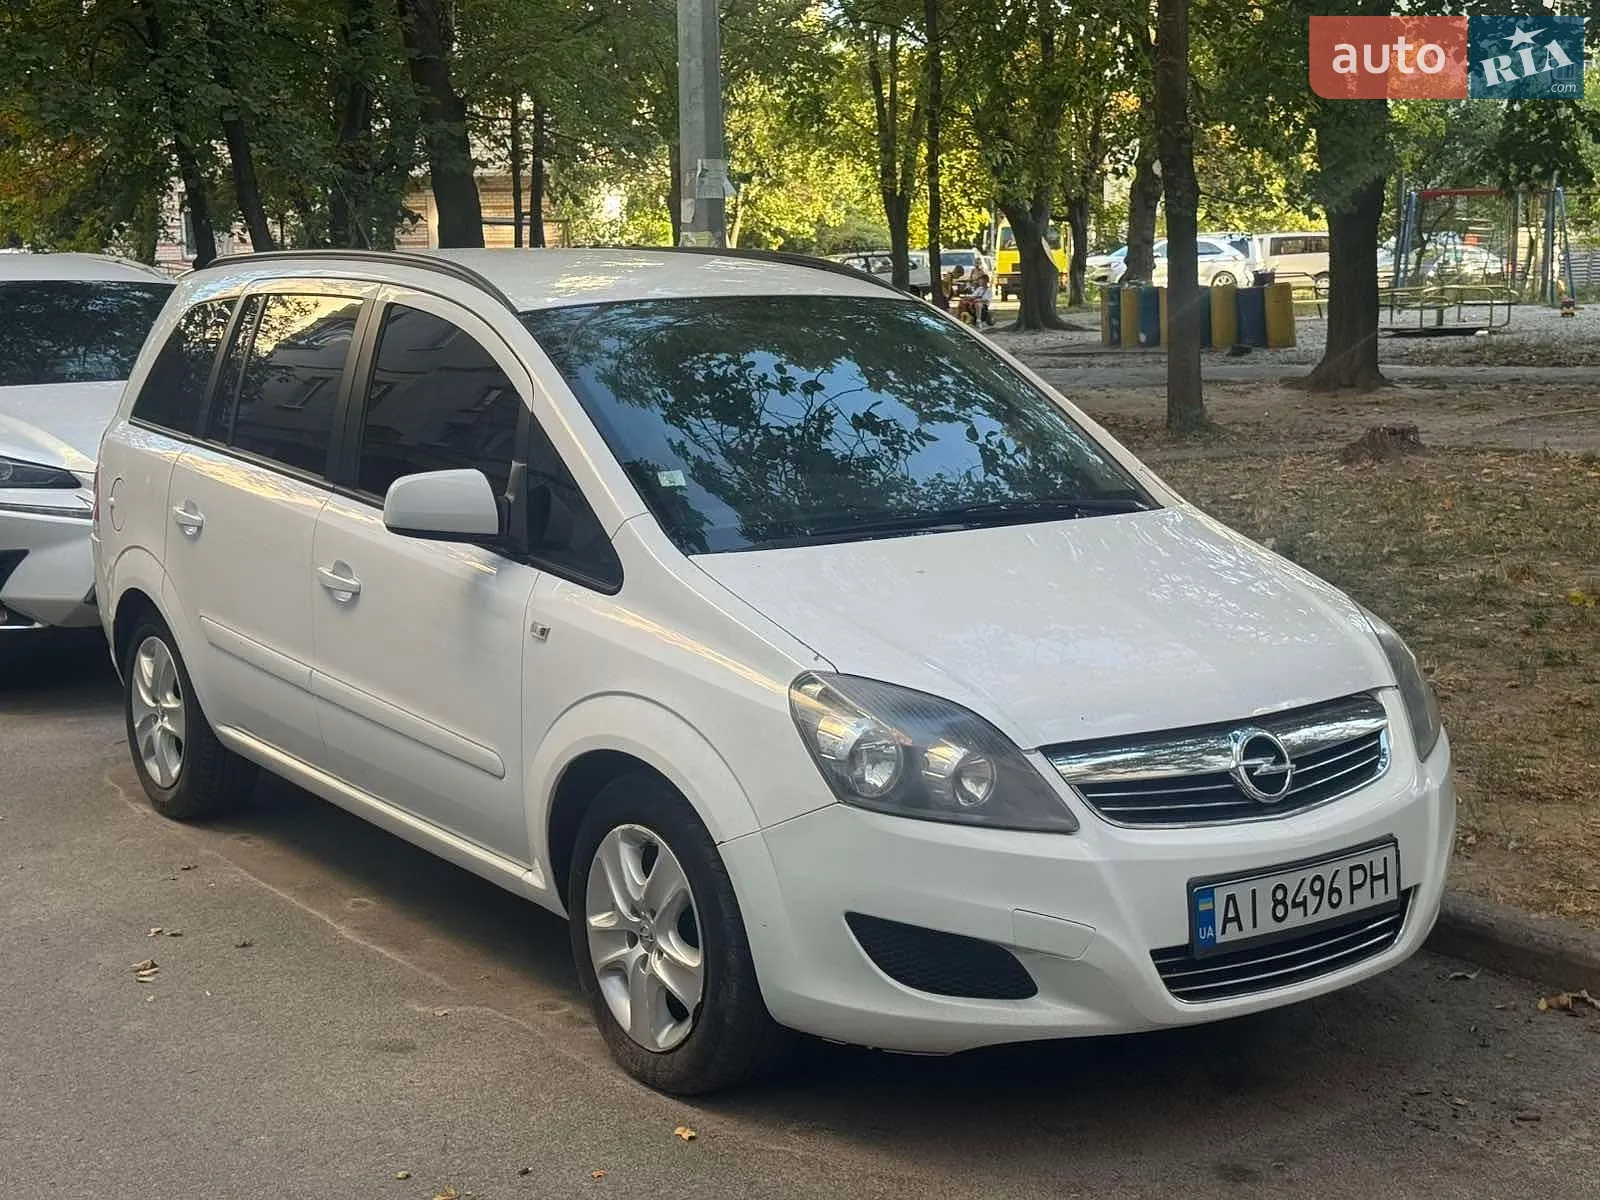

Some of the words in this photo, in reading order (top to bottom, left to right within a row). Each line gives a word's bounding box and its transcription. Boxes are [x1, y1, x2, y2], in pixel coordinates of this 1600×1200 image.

[1220, 888, 1258, 936] AI
[1271, 868, 1343, 923] 8496
[1349, 856, 1389, 905] PH
[1199, 926, 1215, 940] UA
